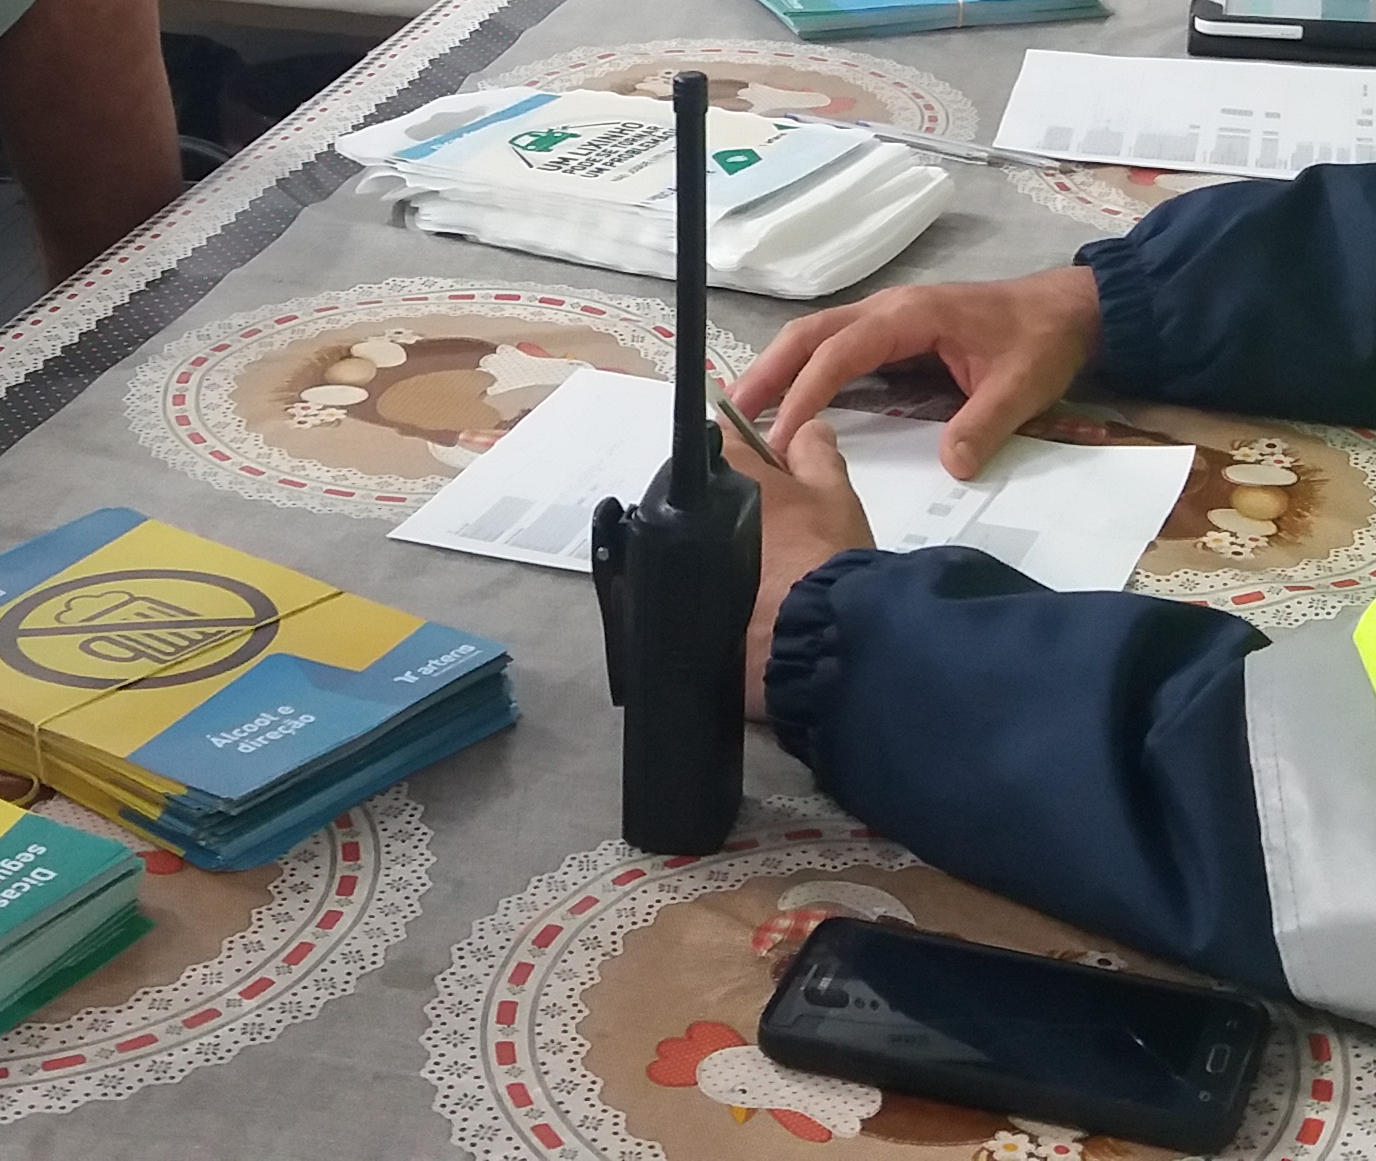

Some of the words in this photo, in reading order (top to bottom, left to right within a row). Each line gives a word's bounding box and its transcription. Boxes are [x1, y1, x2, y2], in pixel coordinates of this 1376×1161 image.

[536, 156, 579, 172] UM
[567, 121, 645, 158] LIXINHO
[561, 156, 603, 175] PODE
[594, 148, 620, 159] SE
[610, 125, 665, 149] TORNAR
[580, 166, 612, 179] UM
[205, 712, 281, 749] Álcool
[277, 705, 295, 715] e
[237, 714, 316, 753] direção
